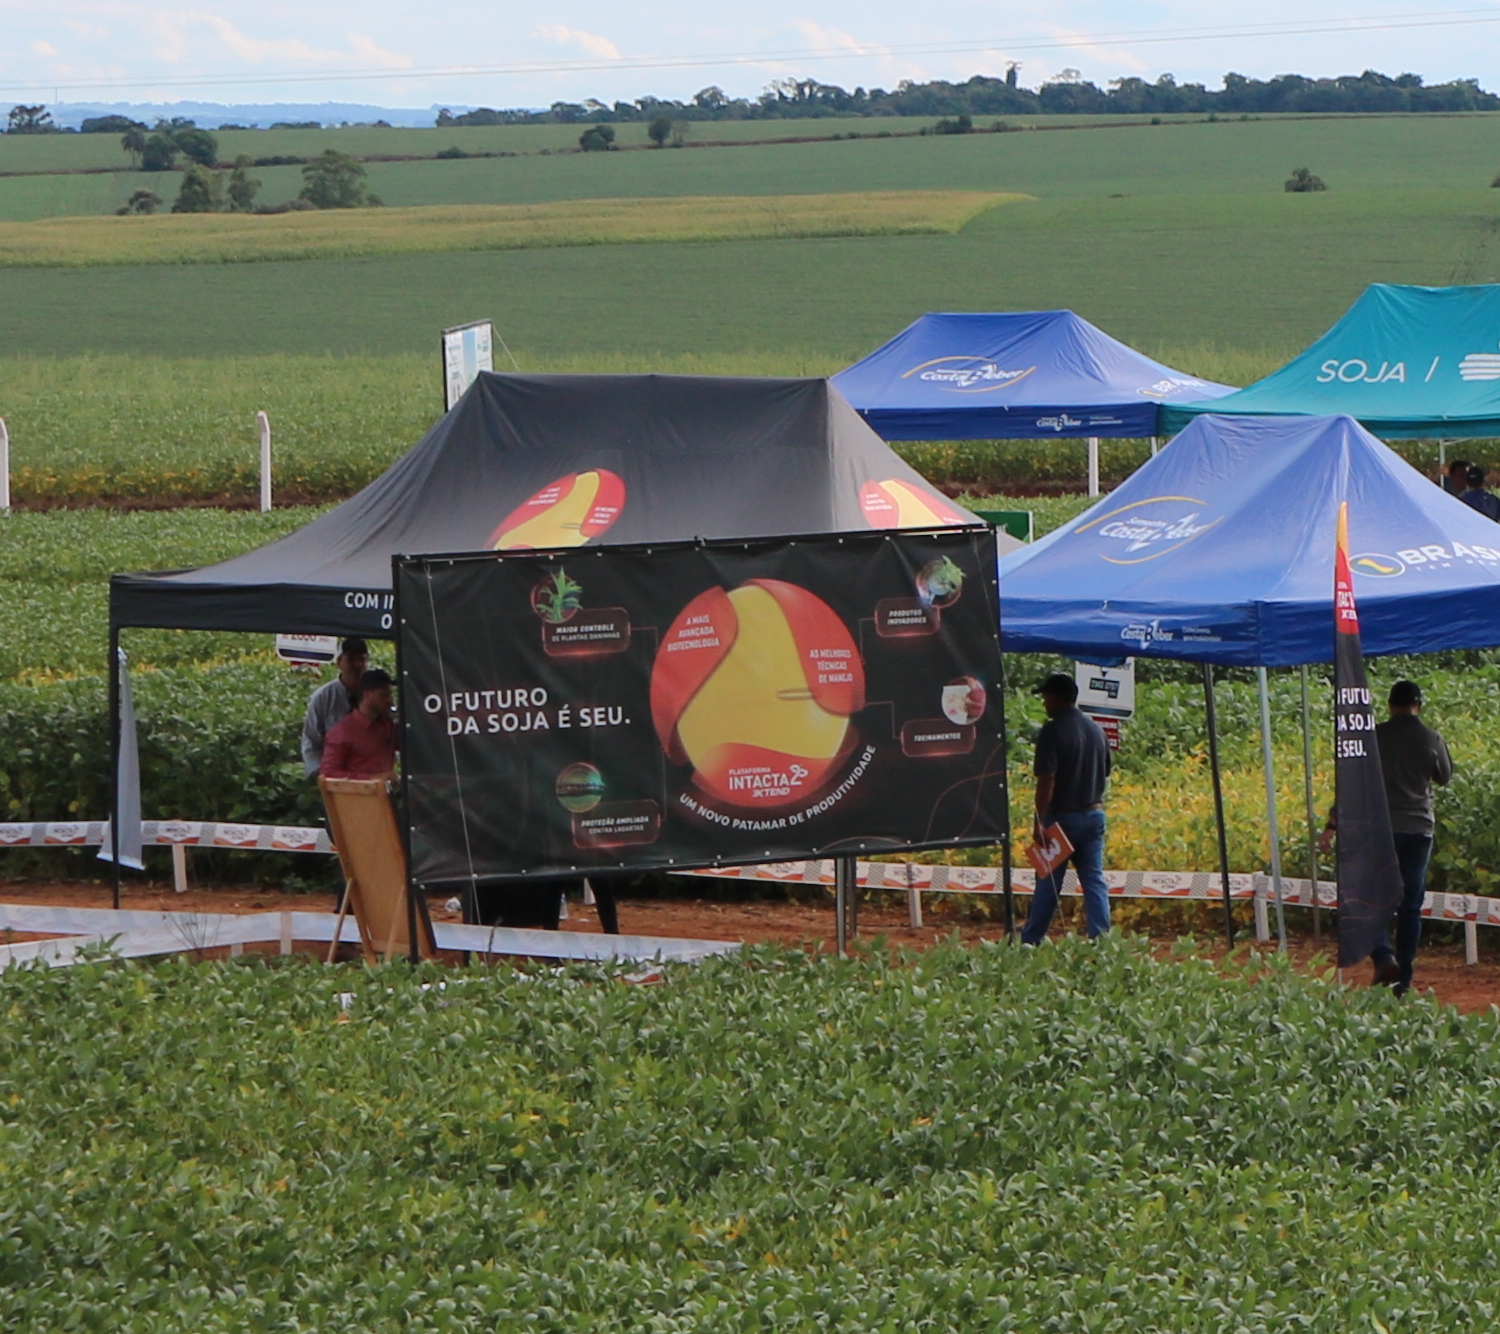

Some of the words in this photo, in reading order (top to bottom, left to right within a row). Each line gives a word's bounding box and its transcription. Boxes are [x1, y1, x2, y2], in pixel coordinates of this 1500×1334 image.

[1315, 358, 1406, 383] SOJA
[344, 592, 379, 609] COM
[694, 614, 709, 624] MAIS
[678, 626, 715, 639] AVANÇADA
[667, 637, 720, 652] BIOTECNOLOGIA
[817, 660, 847, 671] TÉCNICAS
[818, 674, 827, 684] DE
[829, 672, 853, 683] MANEJO
[424, 694, 443, 713] O
[451, 687, 548, 711] FUTURO
[447, 716, 480, 736] DA
[488, 711, 549, 733] SOJA
[558, 705, 571, 728] É
[579, 706, 631, 727] SEU.
[1342, 740, 1367, 758] SEU.
[679, 792, 696, 811] UM
[697, 805, 731, 827] NOVO
[732, 816, 787, 831] PATAMAR
[789, 814, 805, 826] DE
[805, 744, 877, 818] PRODUTIVIDADE
